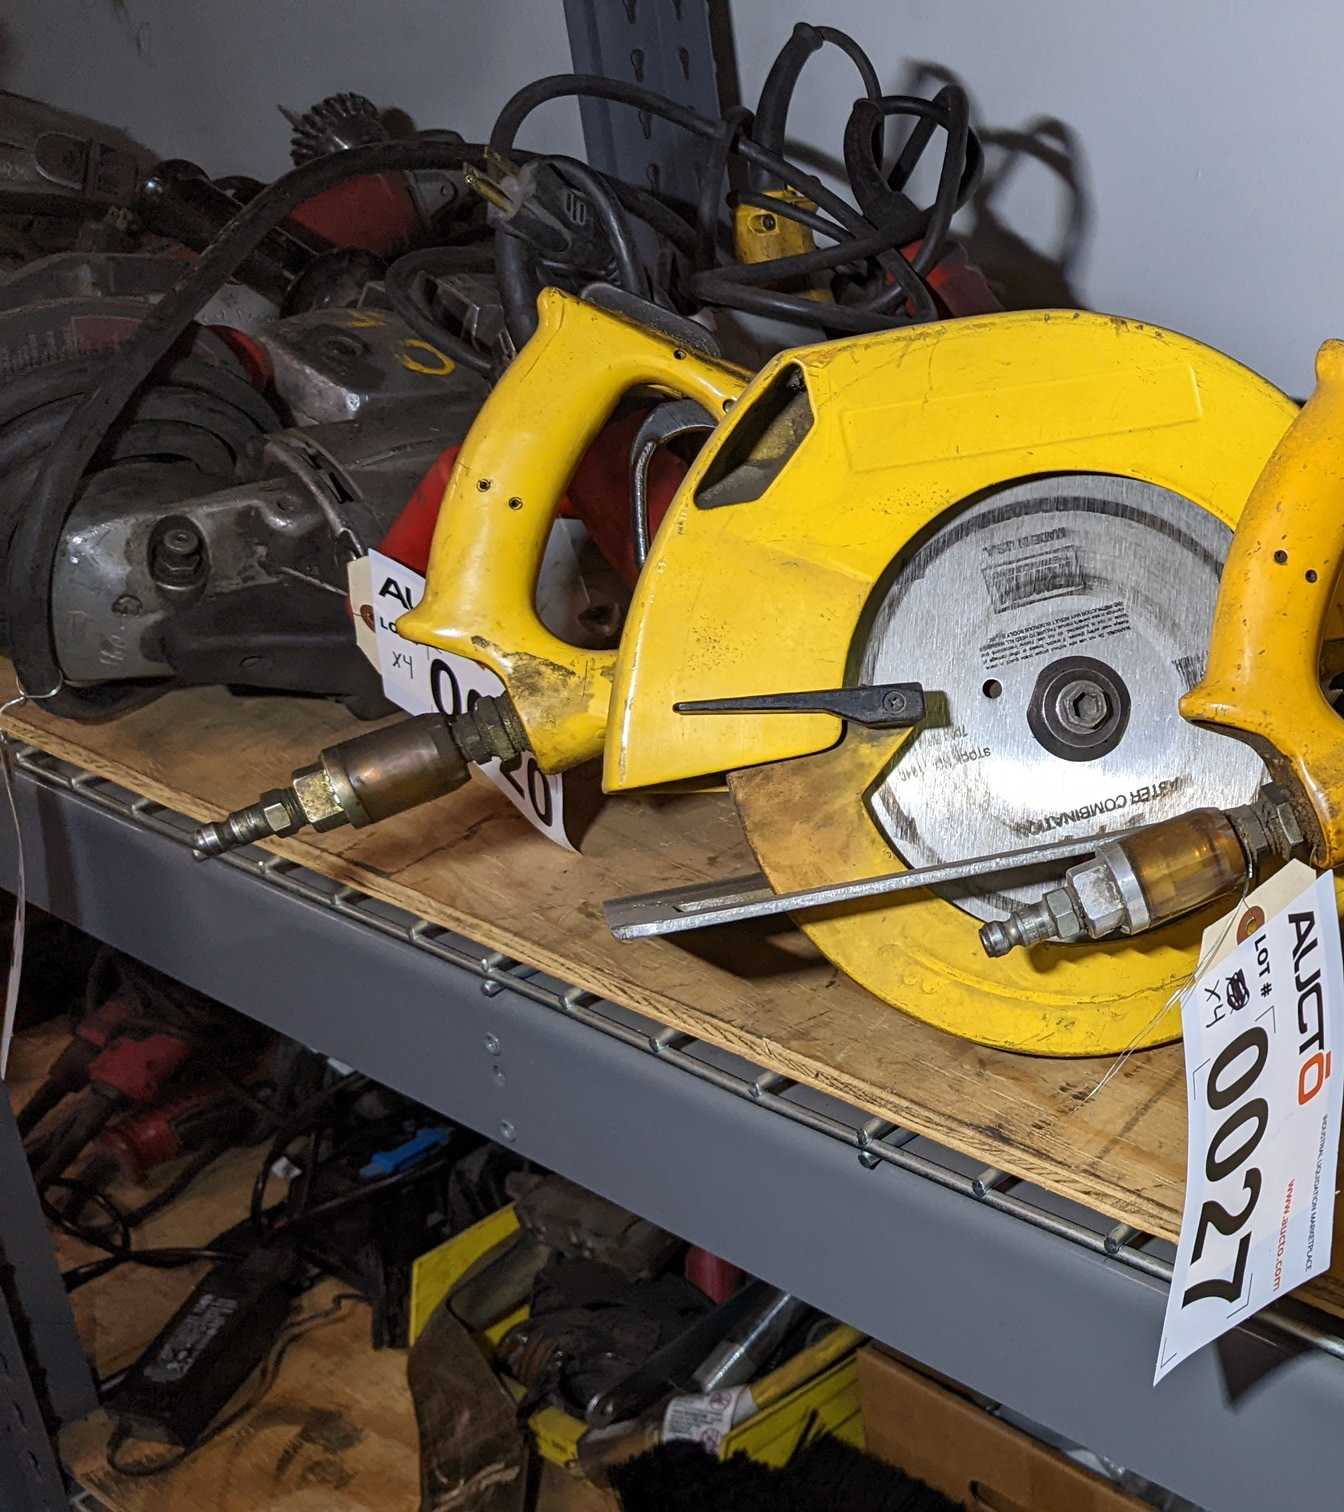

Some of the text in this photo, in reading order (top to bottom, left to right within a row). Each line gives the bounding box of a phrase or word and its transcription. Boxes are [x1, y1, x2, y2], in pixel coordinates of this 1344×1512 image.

[1254, 935, 1273, 999] LOT #
[1182, 1026, 1269, 1310] 0027
[1272, 1178, 1296, 1292] www.aucto.com
